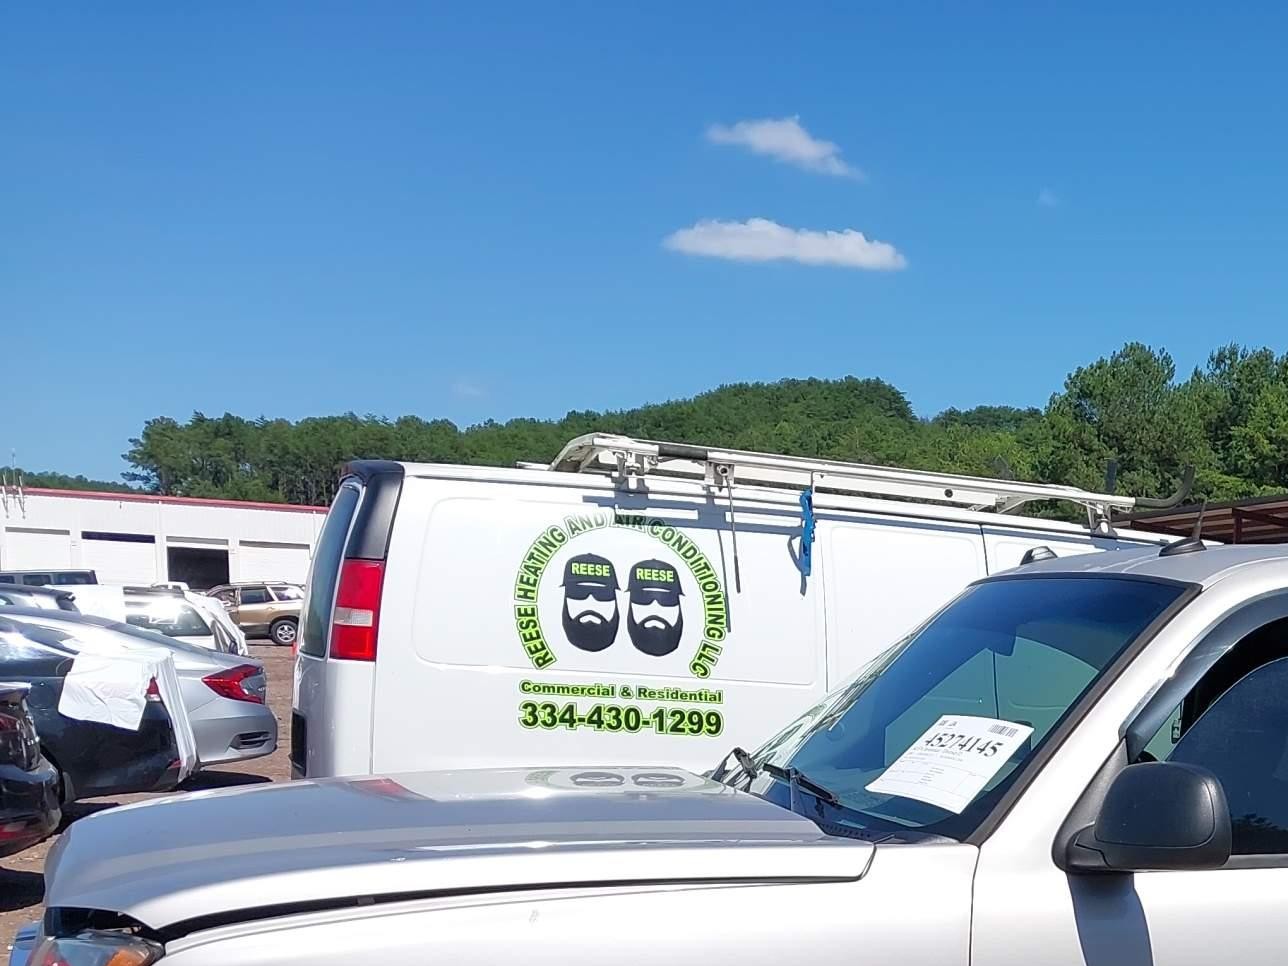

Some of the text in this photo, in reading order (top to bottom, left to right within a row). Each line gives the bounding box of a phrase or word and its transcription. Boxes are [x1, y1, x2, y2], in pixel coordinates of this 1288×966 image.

[571, 562, 610, 577] REESE
[635, 567, 674, 582] REESE
[517, 513, 726, 677] REESE HEATING AND AIR CONDITIONING LLC
[520, 681, 722, 702] Commercial & Residential
[520, 702, 722, 736] 334-430-1299
[925, 732, 1004, 757] 45274145
